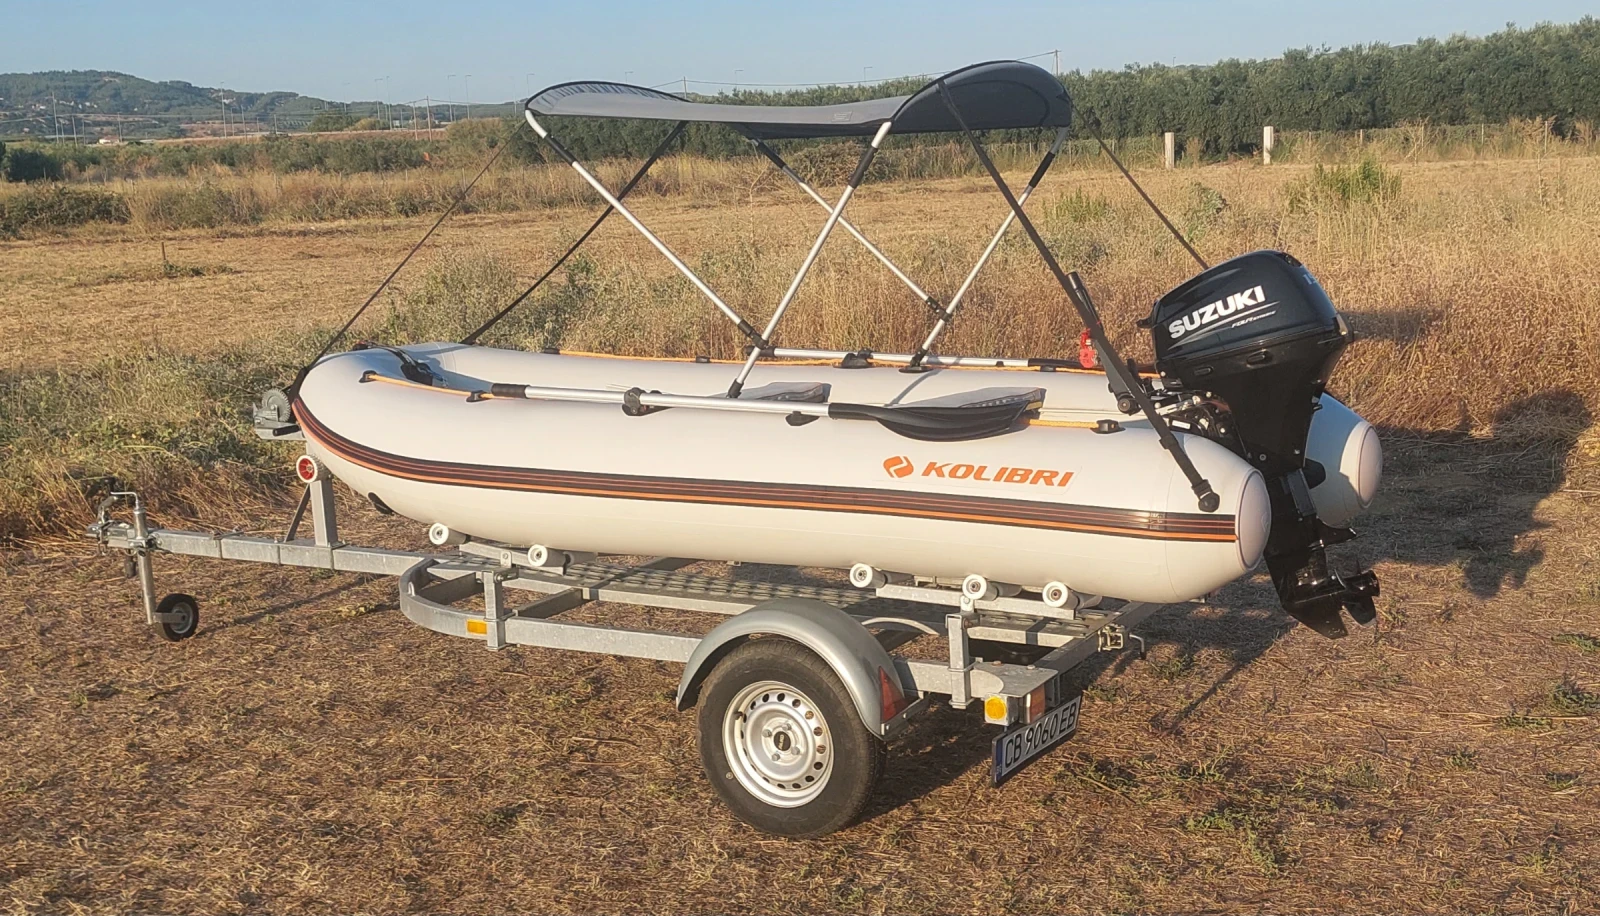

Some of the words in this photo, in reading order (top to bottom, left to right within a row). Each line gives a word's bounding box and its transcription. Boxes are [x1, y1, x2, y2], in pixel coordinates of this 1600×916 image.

[1168, 286, 1266, 339] SUZUKI
[921, 461, 1075, 487] KOLIBRI
[1005, 733, 1022, 768] CB
[1025, 713, 1058, 755] 9060
[1059, 702, 1077, 735] EB
